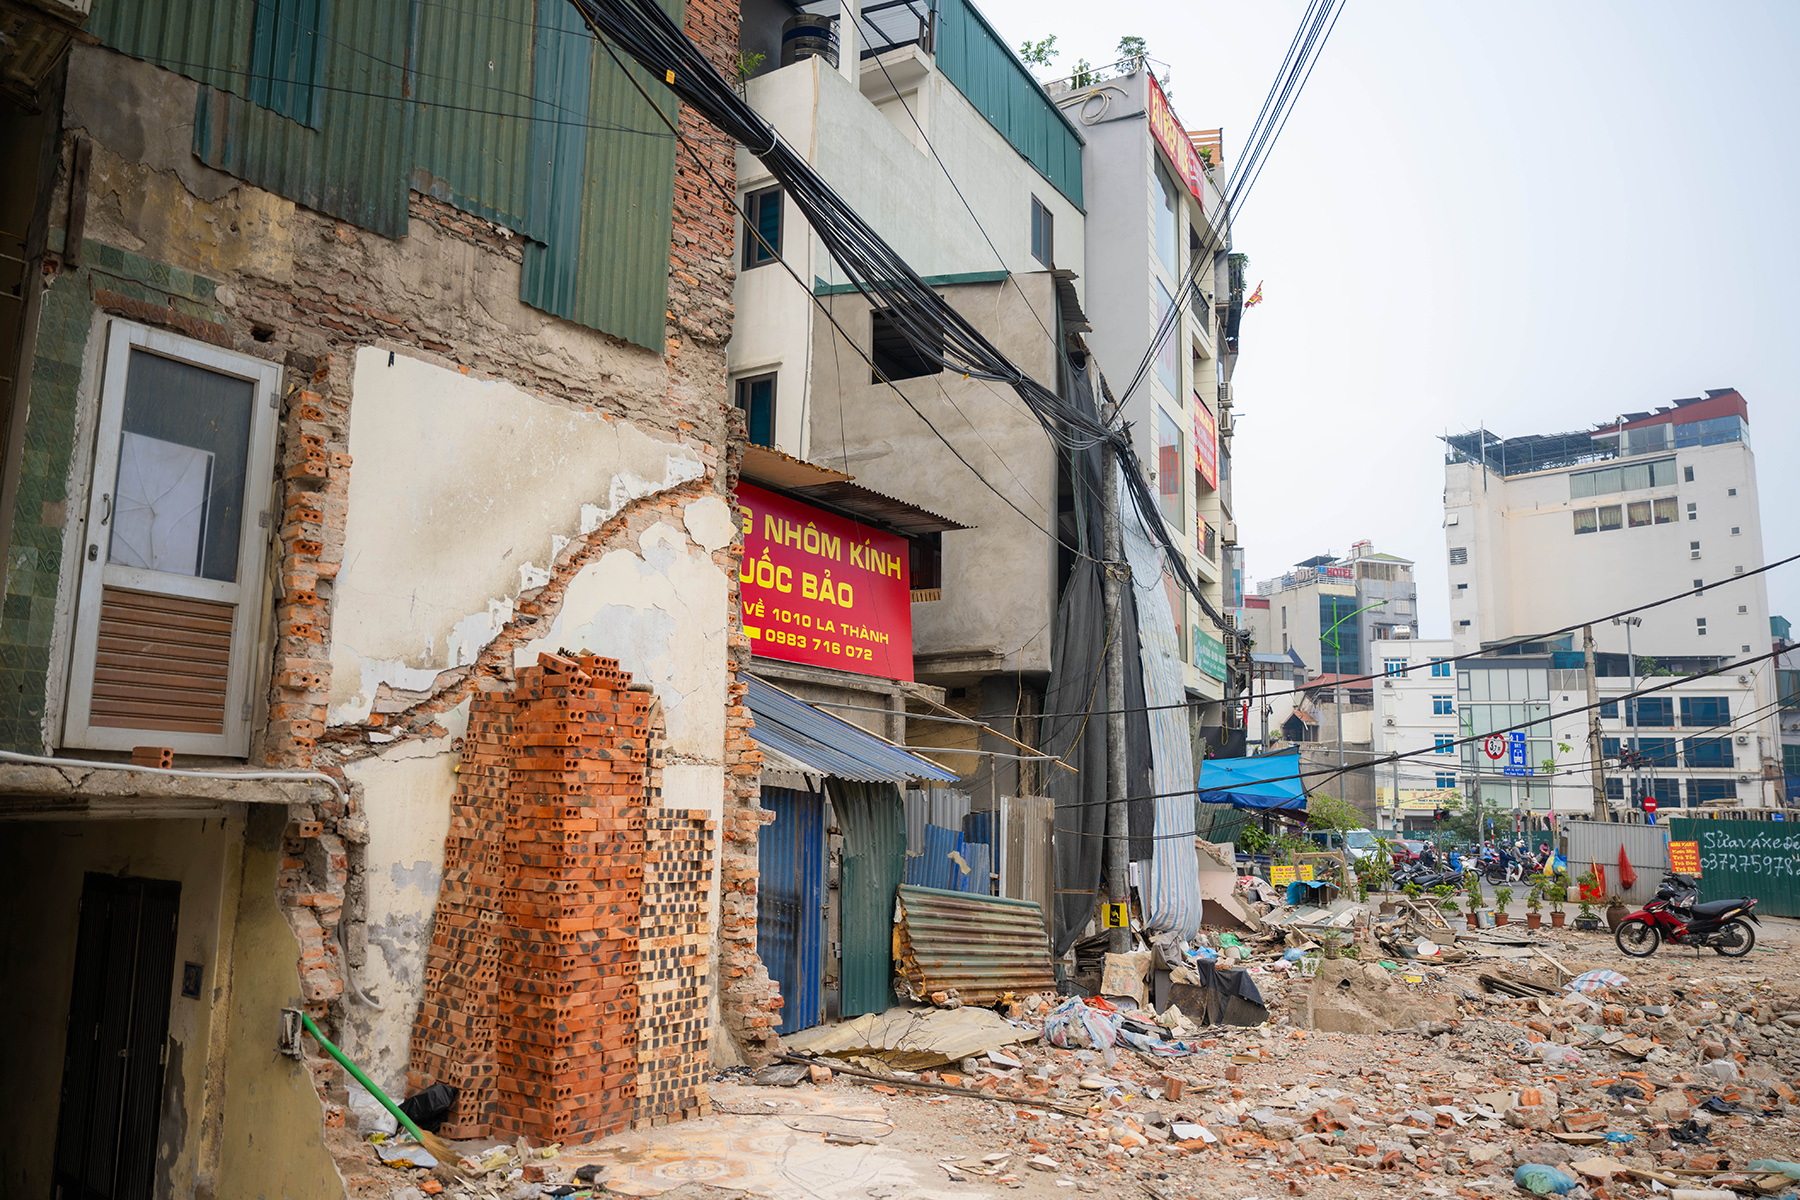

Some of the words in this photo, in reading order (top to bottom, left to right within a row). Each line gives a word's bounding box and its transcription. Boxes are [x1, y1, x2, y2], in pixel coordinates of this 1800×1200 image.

[764, 513, 841, 562] NHÔM
[850, 538, 901, 580] KÍNH
[740, 546, 793, 594] UỐC
[802, 569, 854, 609] BẢO
[1327, 567, 1354, 578] HOTEL
[744, 598, 765, 618] VỀ
[772, 608, 812, 628] 1010
[816, 618, 836, 633] LA
[841, 623, 889, 645] THÀNH
[765, 629, 807, 649] 0983
[813, 638, 841, 655] 716
[845, 645, 873, 661] 072
[1700, 853, 1800, 877] 037275978
